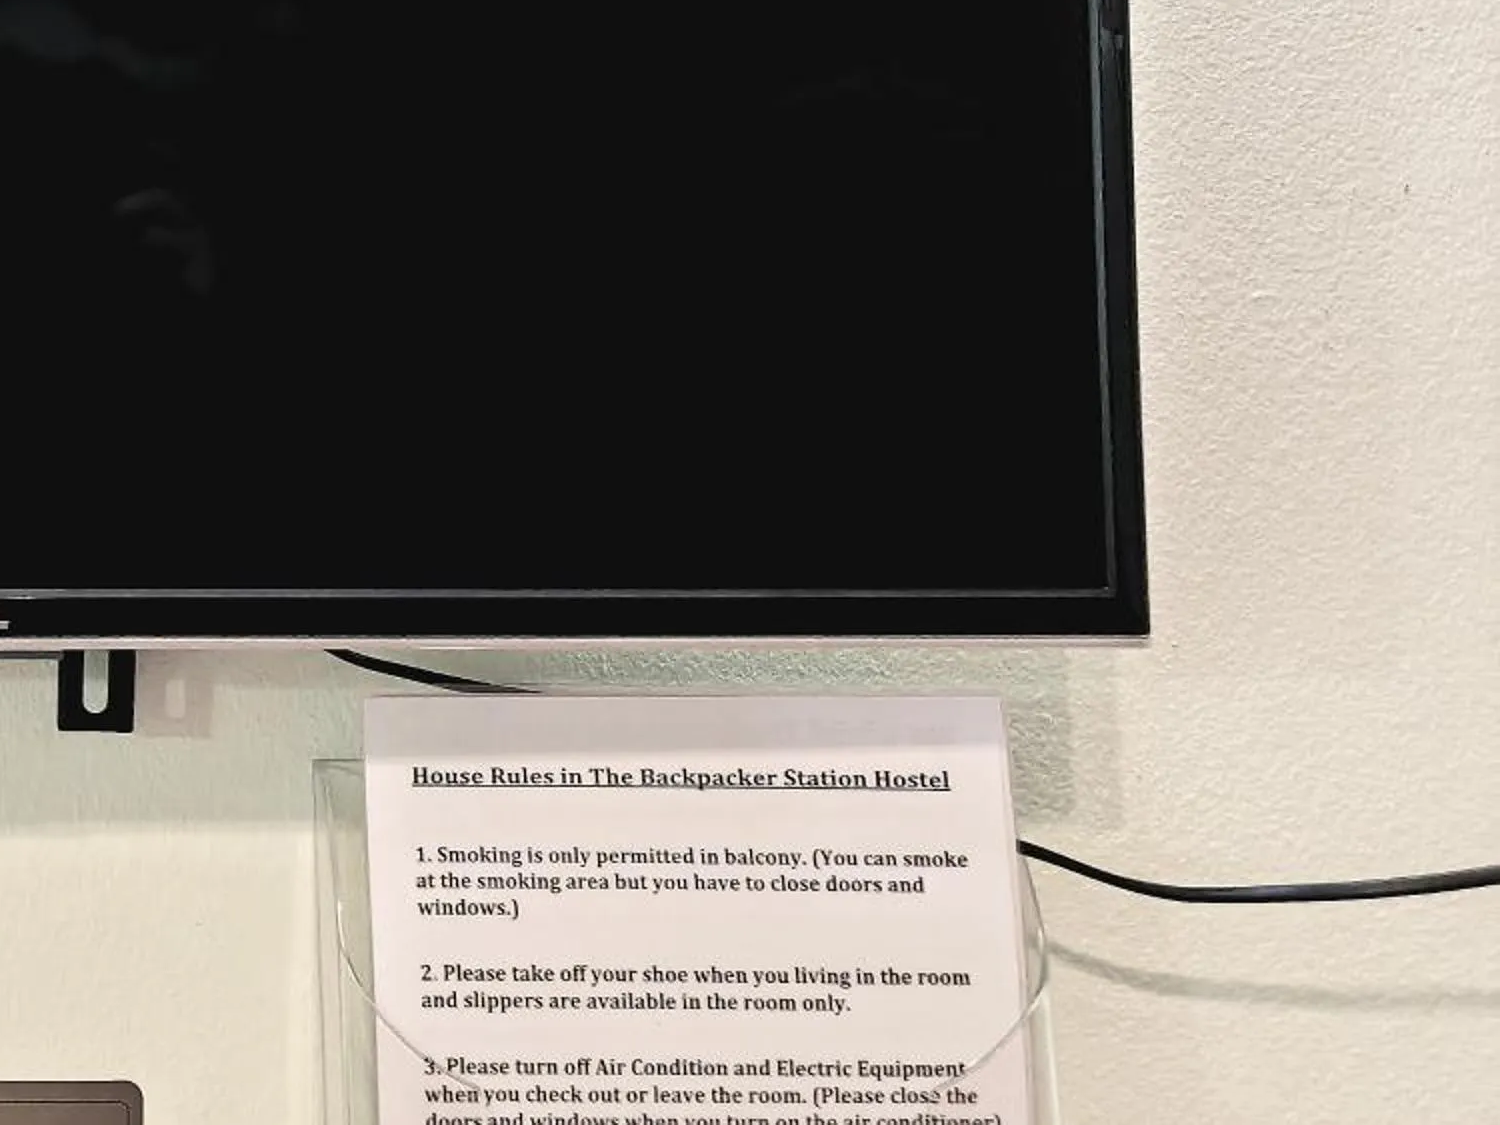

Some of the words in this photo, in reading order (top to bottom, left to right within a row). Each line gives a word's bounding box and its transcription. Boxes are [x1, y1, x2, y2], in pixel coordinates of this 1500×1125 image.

[412, 766, 484, 787] House
[491, 766, 555, 788] Rules
[559, 767, 583, 789] in
[587, 767, 634, 789] The
[639, 768, 779, 790] Backpacker
[783, 769, 867, 791] Station
[874, 770, 950, 792] Hostel
[415, 846, 433, 864] 1.
[436, 845, 524, 868] Smoking
[527, 846, 544, 864] is
[548, 845, 591, 868] only
[595, 846, 696, 869] permitted
[699, 848, 720, 866] in
[723, 847, 808, 870] balcony.
[811, 848, 859, 871] (You
[863, 853, 898, 868] can
[902, 850, 969, 869] smoke
[415, 873, 437, 890] at
[439, 871, 472, 890] the
[476, 872, 563, 895] smoking
[565, 876, 610, 890] area
[613, 872, 649, 891] but
[651, 877, 689, 896] you
[693, 873, 741, 892] have
[744, 875, 766, 892] to
[769, 874, 821, 892] close
[825, 874, 883, 894] doors
[887, 875, 926, 894] and
[417, 898, 520, 921] windows.)
[419, 963, 439, 983] 2.
[442, 962, 507, 982] Please
[511, 963, 556, 983] take
[559, 964, 589, 983] off
[590, 968, 639, 988] your
[641, 964, 689, 984] shoe
[692, 965, 749, 984] when
[751, 970, 790, 989] you
[793, 966, 853, 991] living
[855, 967, 876, 986] in
[879, 966, 913, 986] the
[917, 972, 972, 988] room
[421, 990, 459, 1009] and
[463, 990, 545, 1014] slippers
[548, 996, 582, 1010] are
[585, 991, 677, 1011] available
[681, 992, 702, 1011] in
[706, 992, 739, 1011] the
[742, 997, 798, 1012] room
[801, 992, 852, 1017] only.
[446, 1056, 511, 1075] Please
[514, 1058, 559, 1076] turn
[563, 1057, 593, 1076] off
[595, 1058, 627, 1076] Air
[630, 1057, 729, 1077] Condition
[733, 1058, 771, 1077] and
[776, 1058, 853, 1078] Electric
[857, 1059, 966, 1081] Equipment
[424, 1084, 481, 1104] when
[483, 1088, 521, 1107] you
[525, 1085, 584, 1104] check
[587, 1087, 621, 1104] out
[625, 1090, 649, 1104] or
[653, 1085, 706, 1104] leave
[711, 1086, 744, 1105] the
[748, 1090, 808, 1105] room.
[813, 1086, 886, 1110] (Please
[946, 1087, 979, 1105] the
